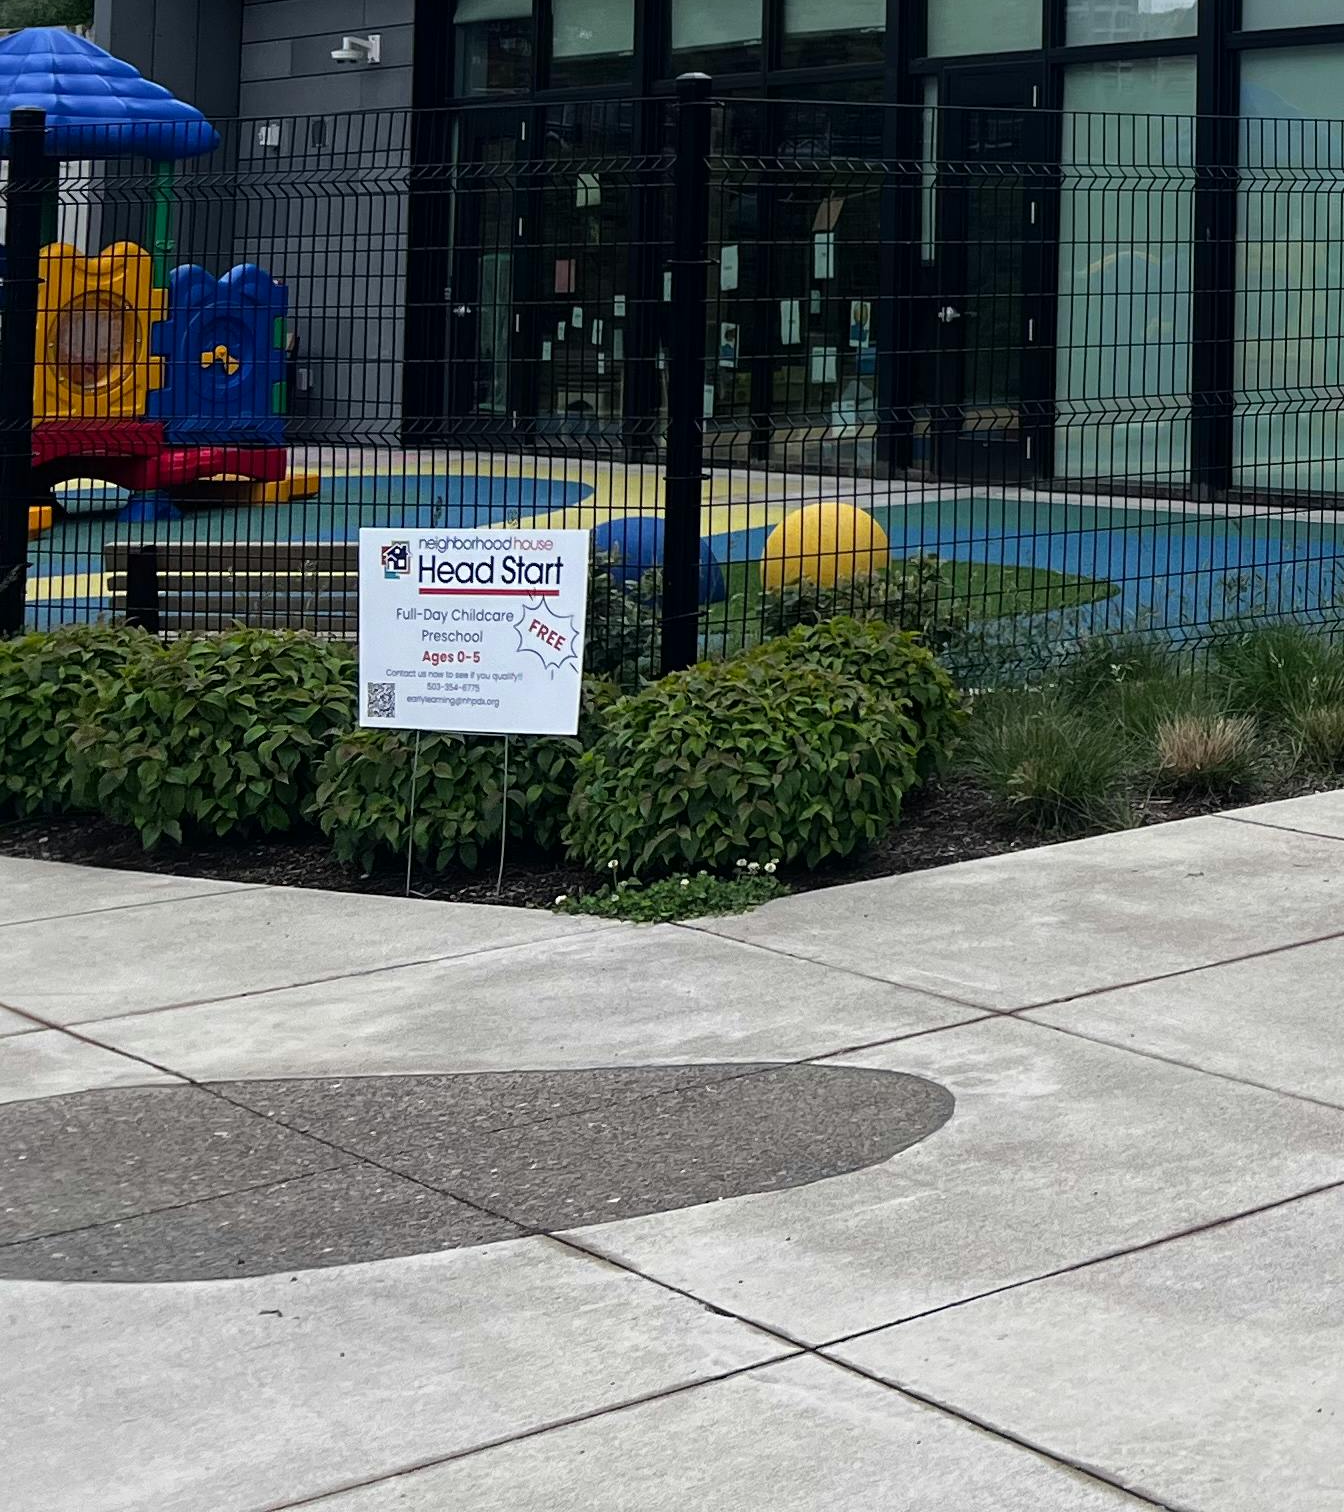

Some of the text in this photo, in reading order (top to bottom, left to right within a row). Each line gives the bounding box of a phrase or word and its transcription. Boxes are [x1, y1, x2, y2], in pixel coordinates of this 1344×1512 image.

[418, 554, 564, 585] Head Start
[396, 607, 515, 624] Full-Day Childcare
[421, 629, 484, 643] Preschool
[528, 619, 567, 652] FREE
[422, 650, 481, 666] Ages 0-5
[386, 669, 416, 678] Contact
[445, 670, 454, 678] to
[476, 672, 490, 681] you
